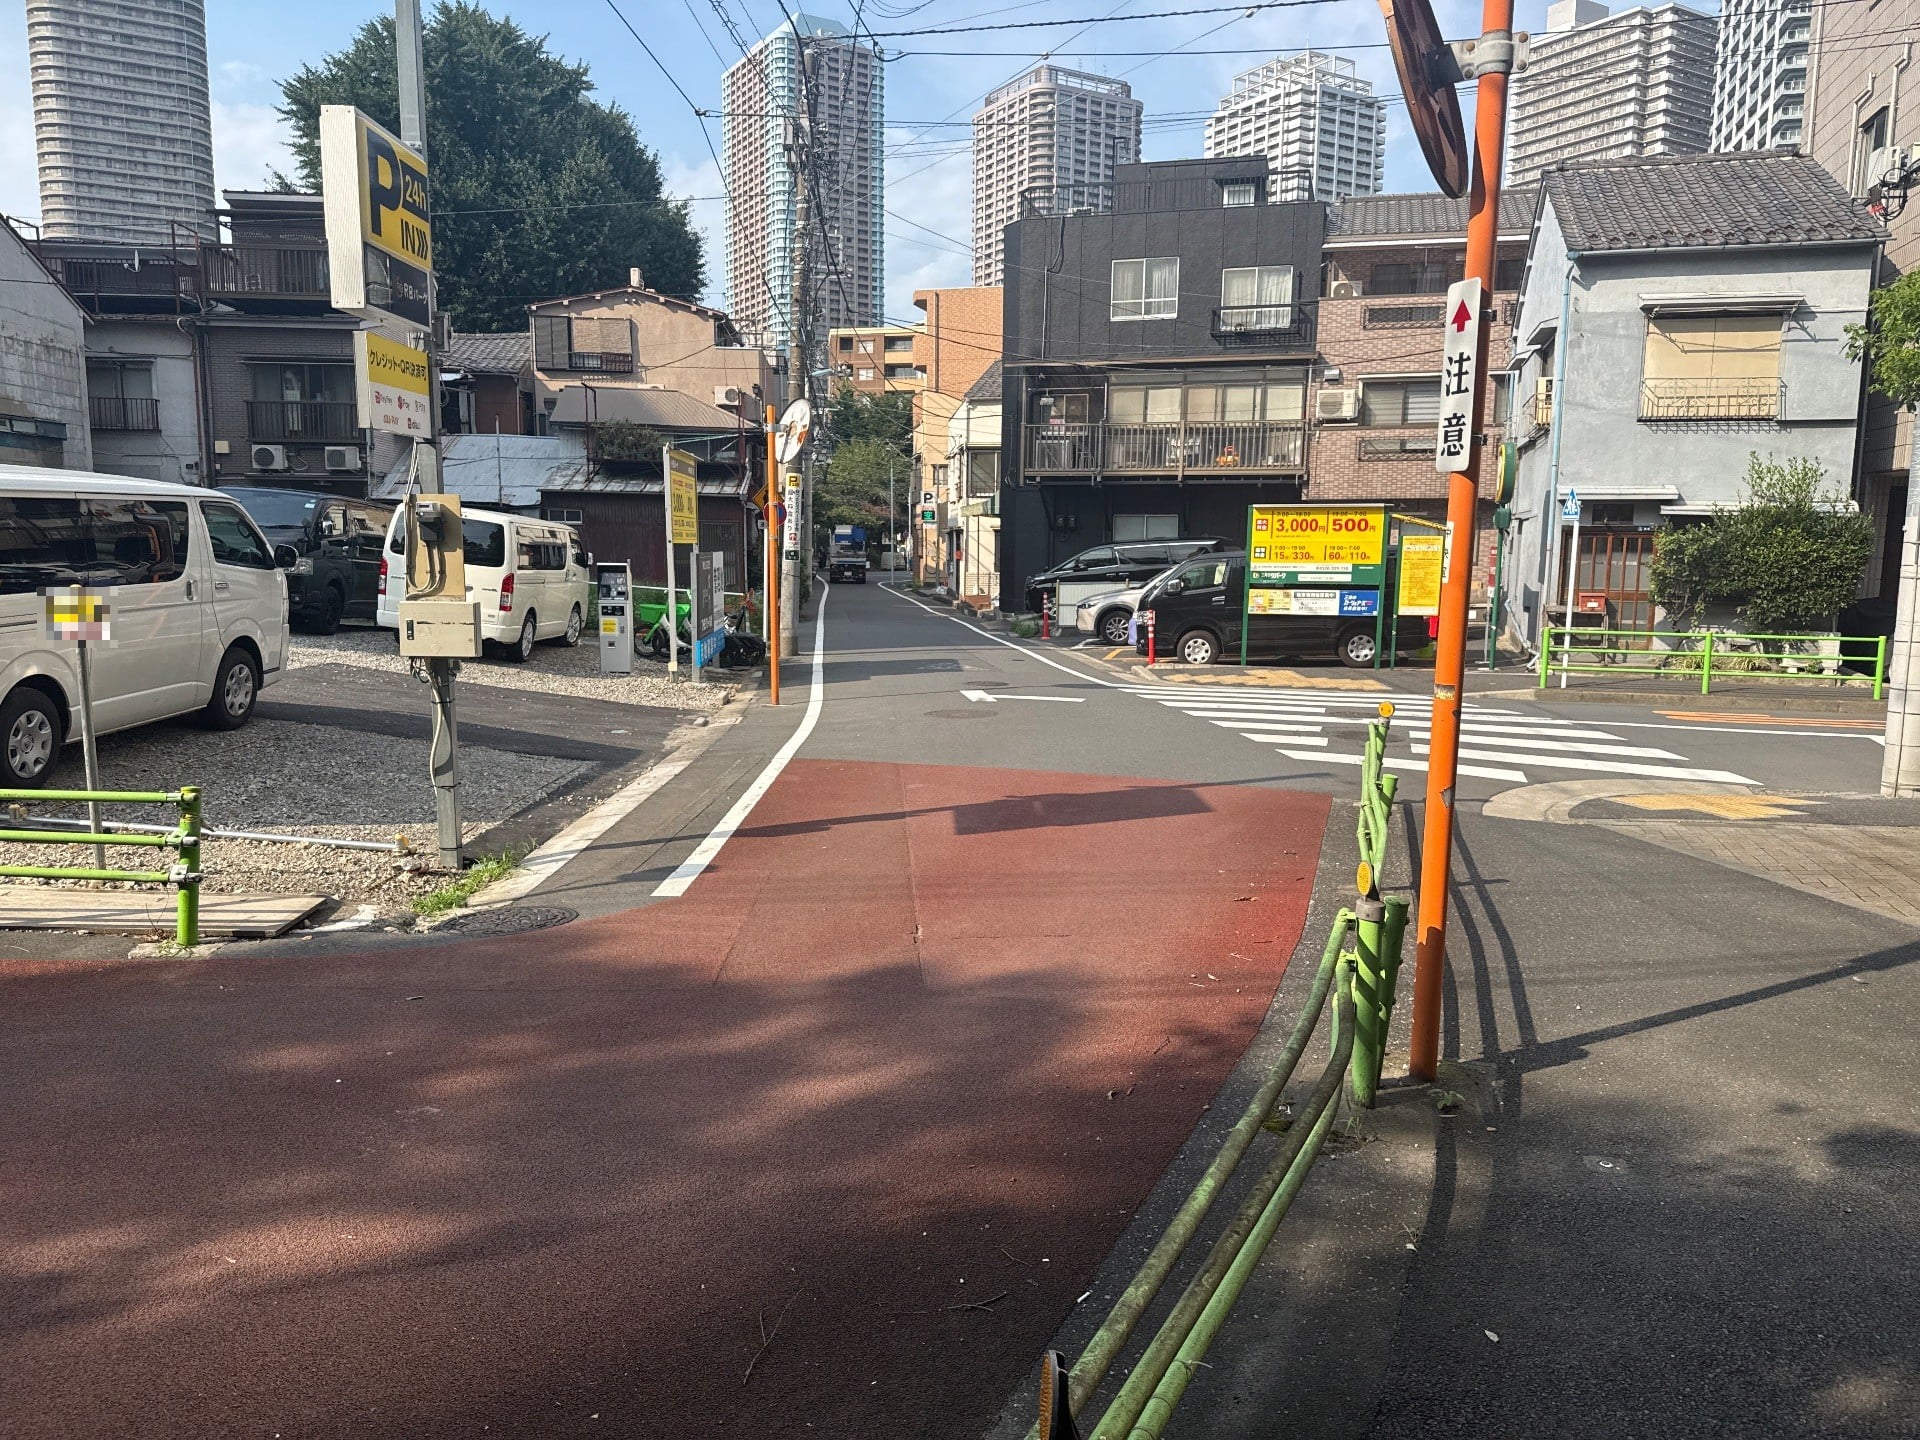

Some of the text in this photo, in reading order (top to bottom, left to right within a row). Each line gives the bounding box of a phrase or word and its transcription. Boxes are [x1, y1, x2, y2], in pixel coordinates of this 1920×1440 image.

[367, 127, 402, 238] P
[405, 177, 427, 214] 24h
[401, 218, 416, 255] IN
[1440, 352, 1471, 456] 注意
[789, 476, 797, 486] P
[923, 492, 933, 504] P
[1276, 518, 1325, 532] 3,000円
[1332, 518, 1376, 532] 500円
